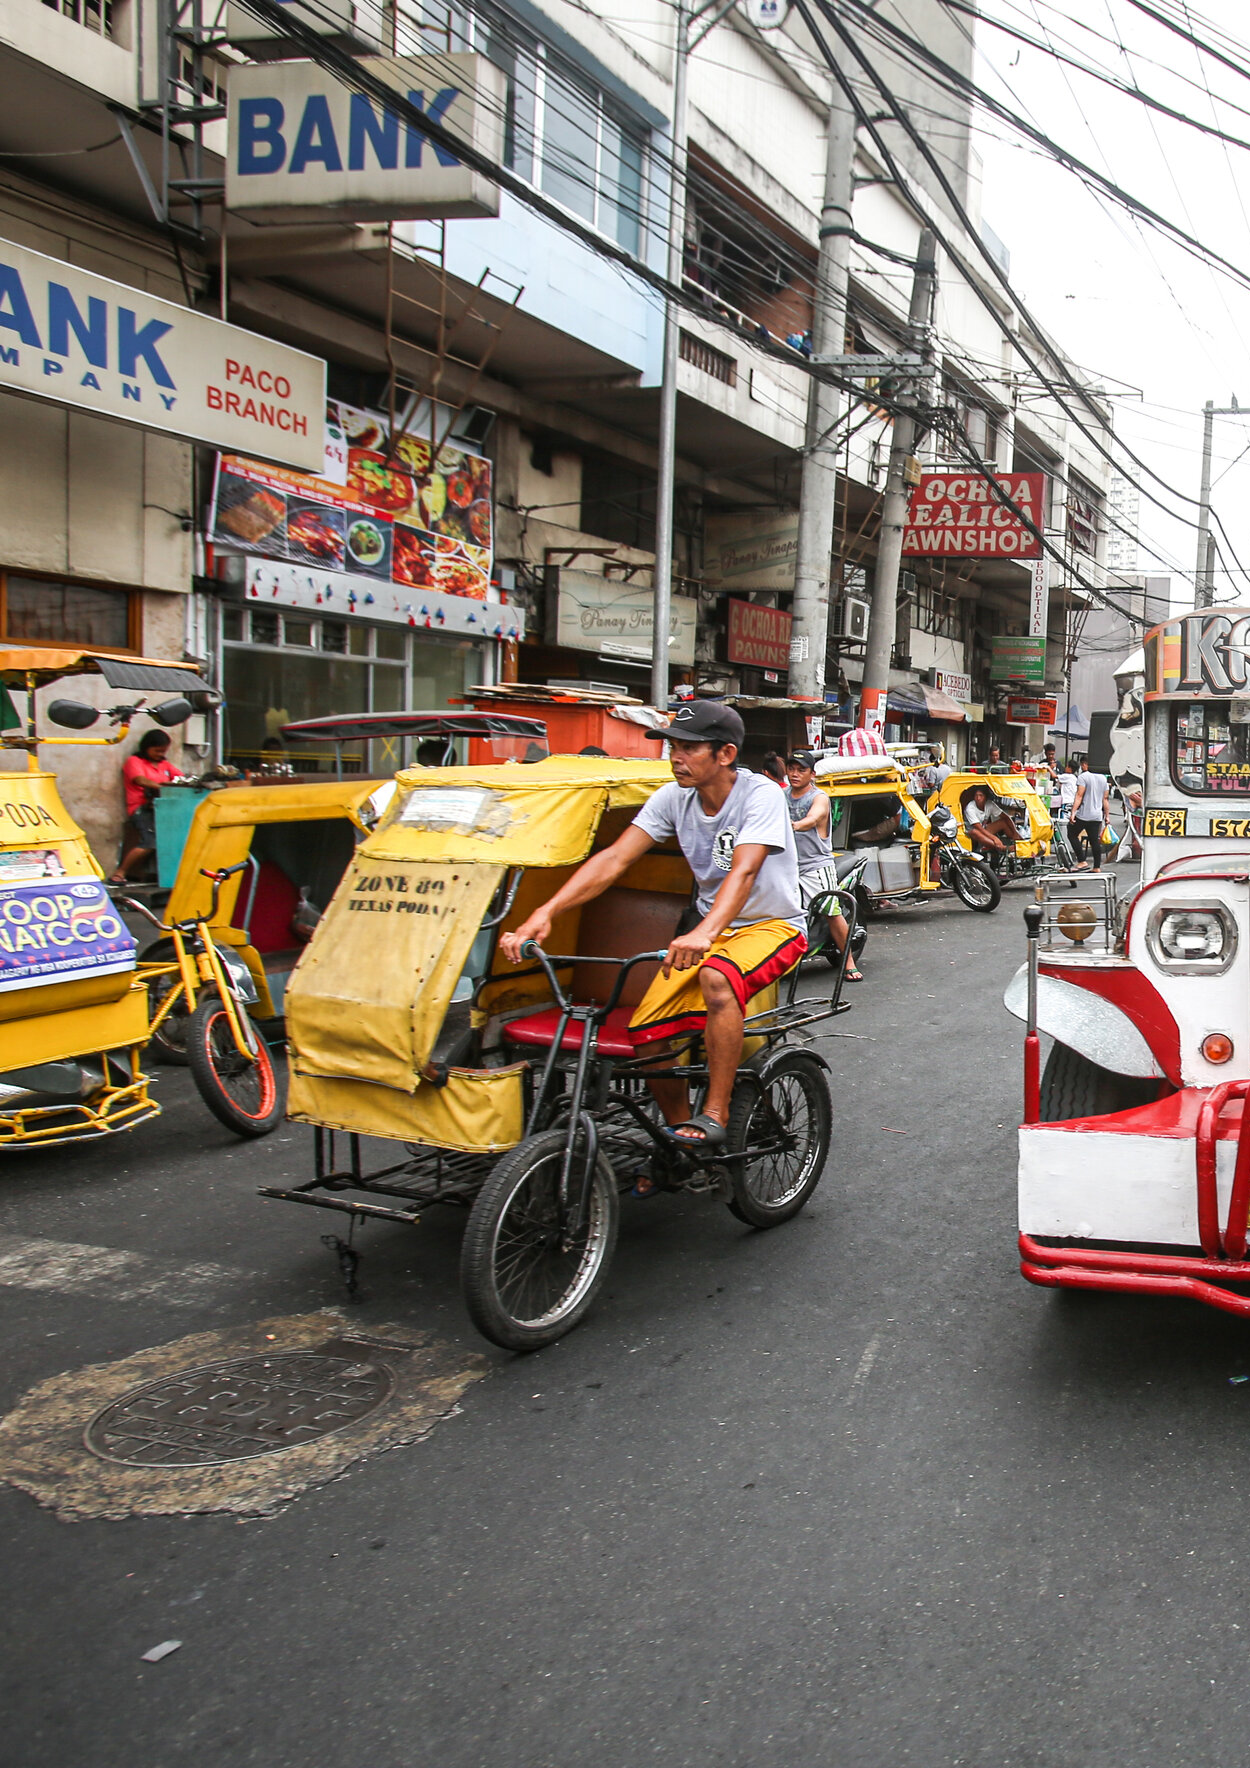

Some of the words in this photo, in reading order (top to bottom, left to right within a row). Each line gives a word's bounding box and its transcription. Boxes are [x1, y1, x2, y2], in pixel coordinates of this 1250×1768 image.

[237, 87, 462, 176] BANK
[225, 358, 291, 399] PACO
[206, 385, 308, 436] BRANCH
[925, 479, 1033, 503] OCHOA
[580, 607, 626, 634] Panay
[1034, 584, 1043, 634] OPTICAL
[742, 607, 776, 643] OCHOA
[943, 674, 970, 691] ACEBEDO
[1148, 818, 1183, 836] 142
[354, 875, 411, 892] ZONE
[348, 899, 394, 912] TEXAS
